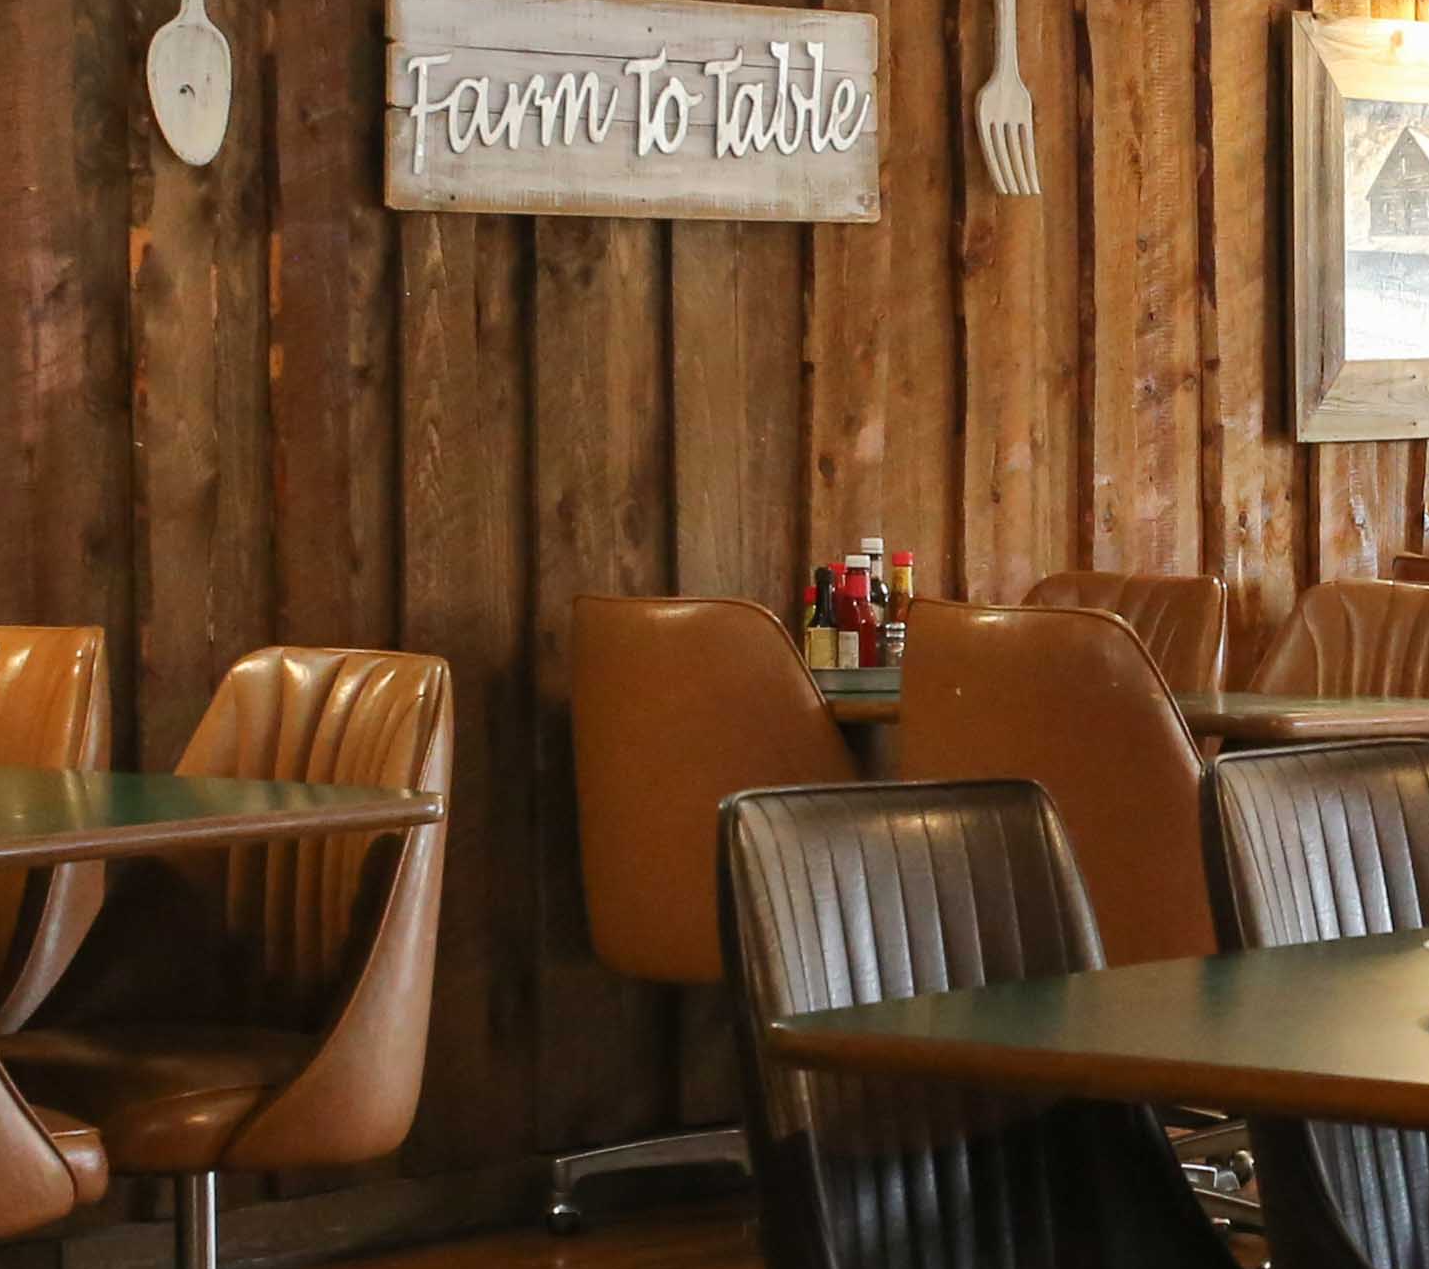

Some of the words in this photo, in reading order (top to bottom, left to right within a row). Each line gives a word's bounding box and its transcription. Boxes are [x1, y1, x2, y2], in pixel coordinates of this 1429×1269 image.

[408, 52, 619, 175] Farm
[624, 41, 704, 157] To
[704, 41, 871, 158] Table
